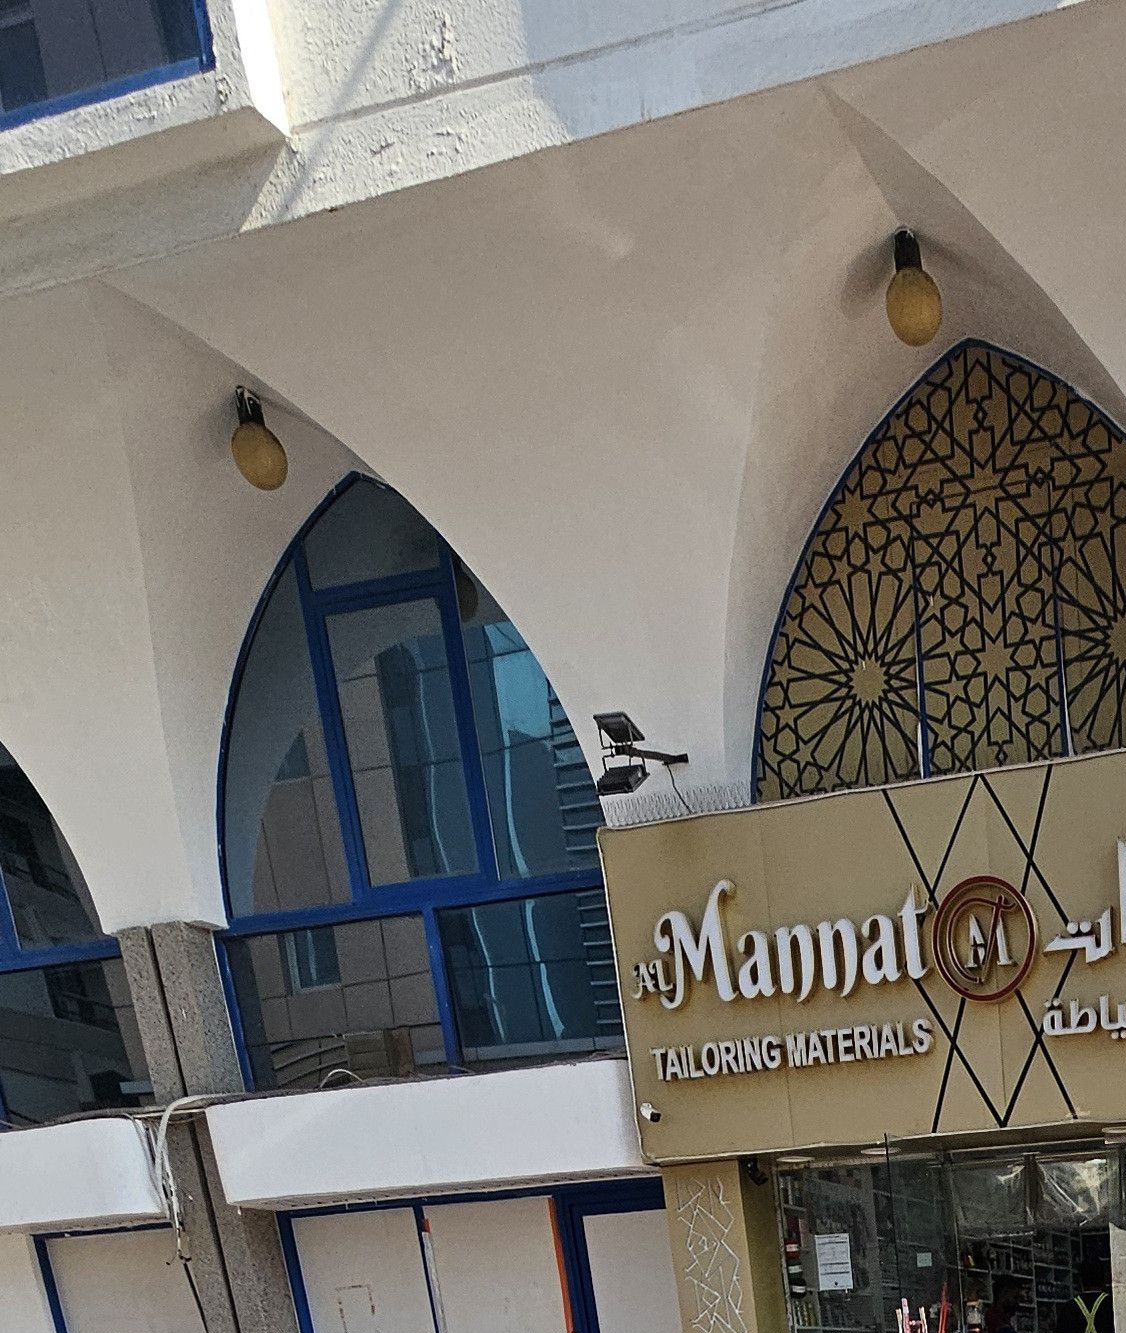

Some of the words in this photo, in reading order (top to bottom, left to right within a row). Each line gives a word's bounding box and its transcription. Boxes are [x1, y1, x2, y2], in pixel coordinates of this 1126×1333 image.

[654, 880, 931, 1010] Mannat
[651, 1034, 784, 1081] TAILORING
[786, 1018, 935, 1068] MATERIALS
